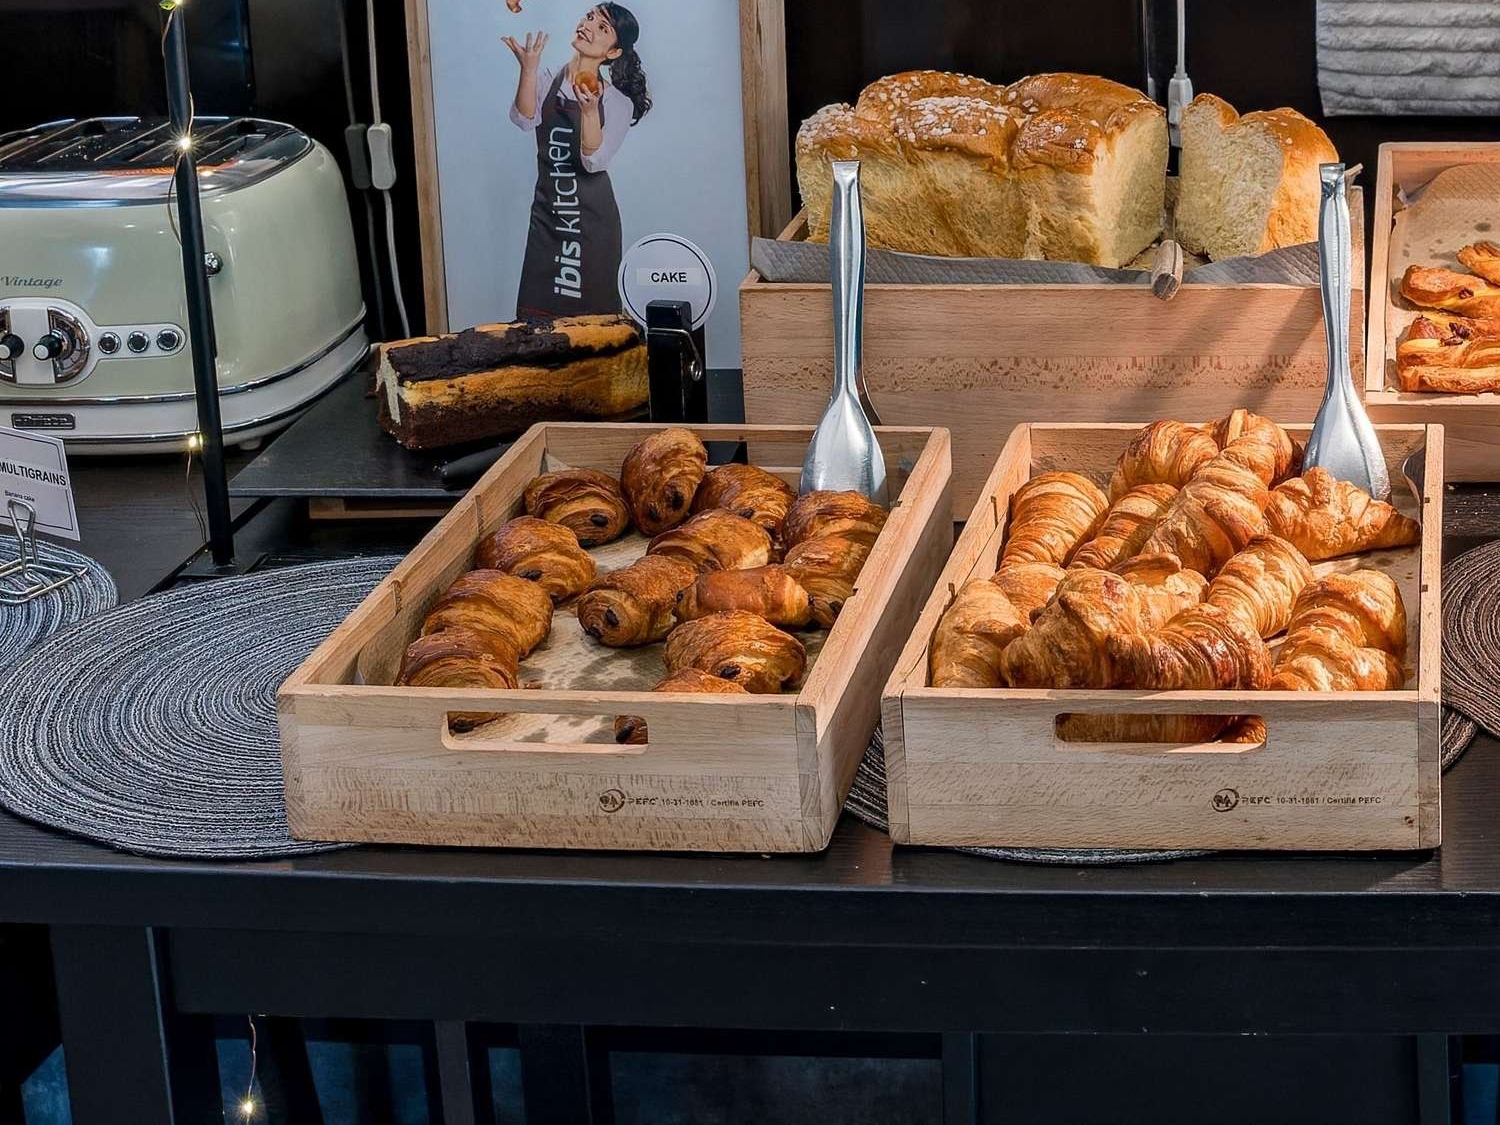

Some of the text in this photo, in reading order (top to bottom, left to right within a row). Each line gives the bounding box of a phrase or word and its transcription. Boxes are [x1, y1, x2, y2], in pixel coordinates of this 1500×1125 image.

[548, 126, 582, 299] ibis kitchen
[0, 276, 63, 289] Vintage
[651, 272, 687, 283] CAKE
[0, 462, 67, 486] MULTIGRAINS
[742, 800, 765, 808] PEFC
[1358, 796, 1381, 805] PEFC
